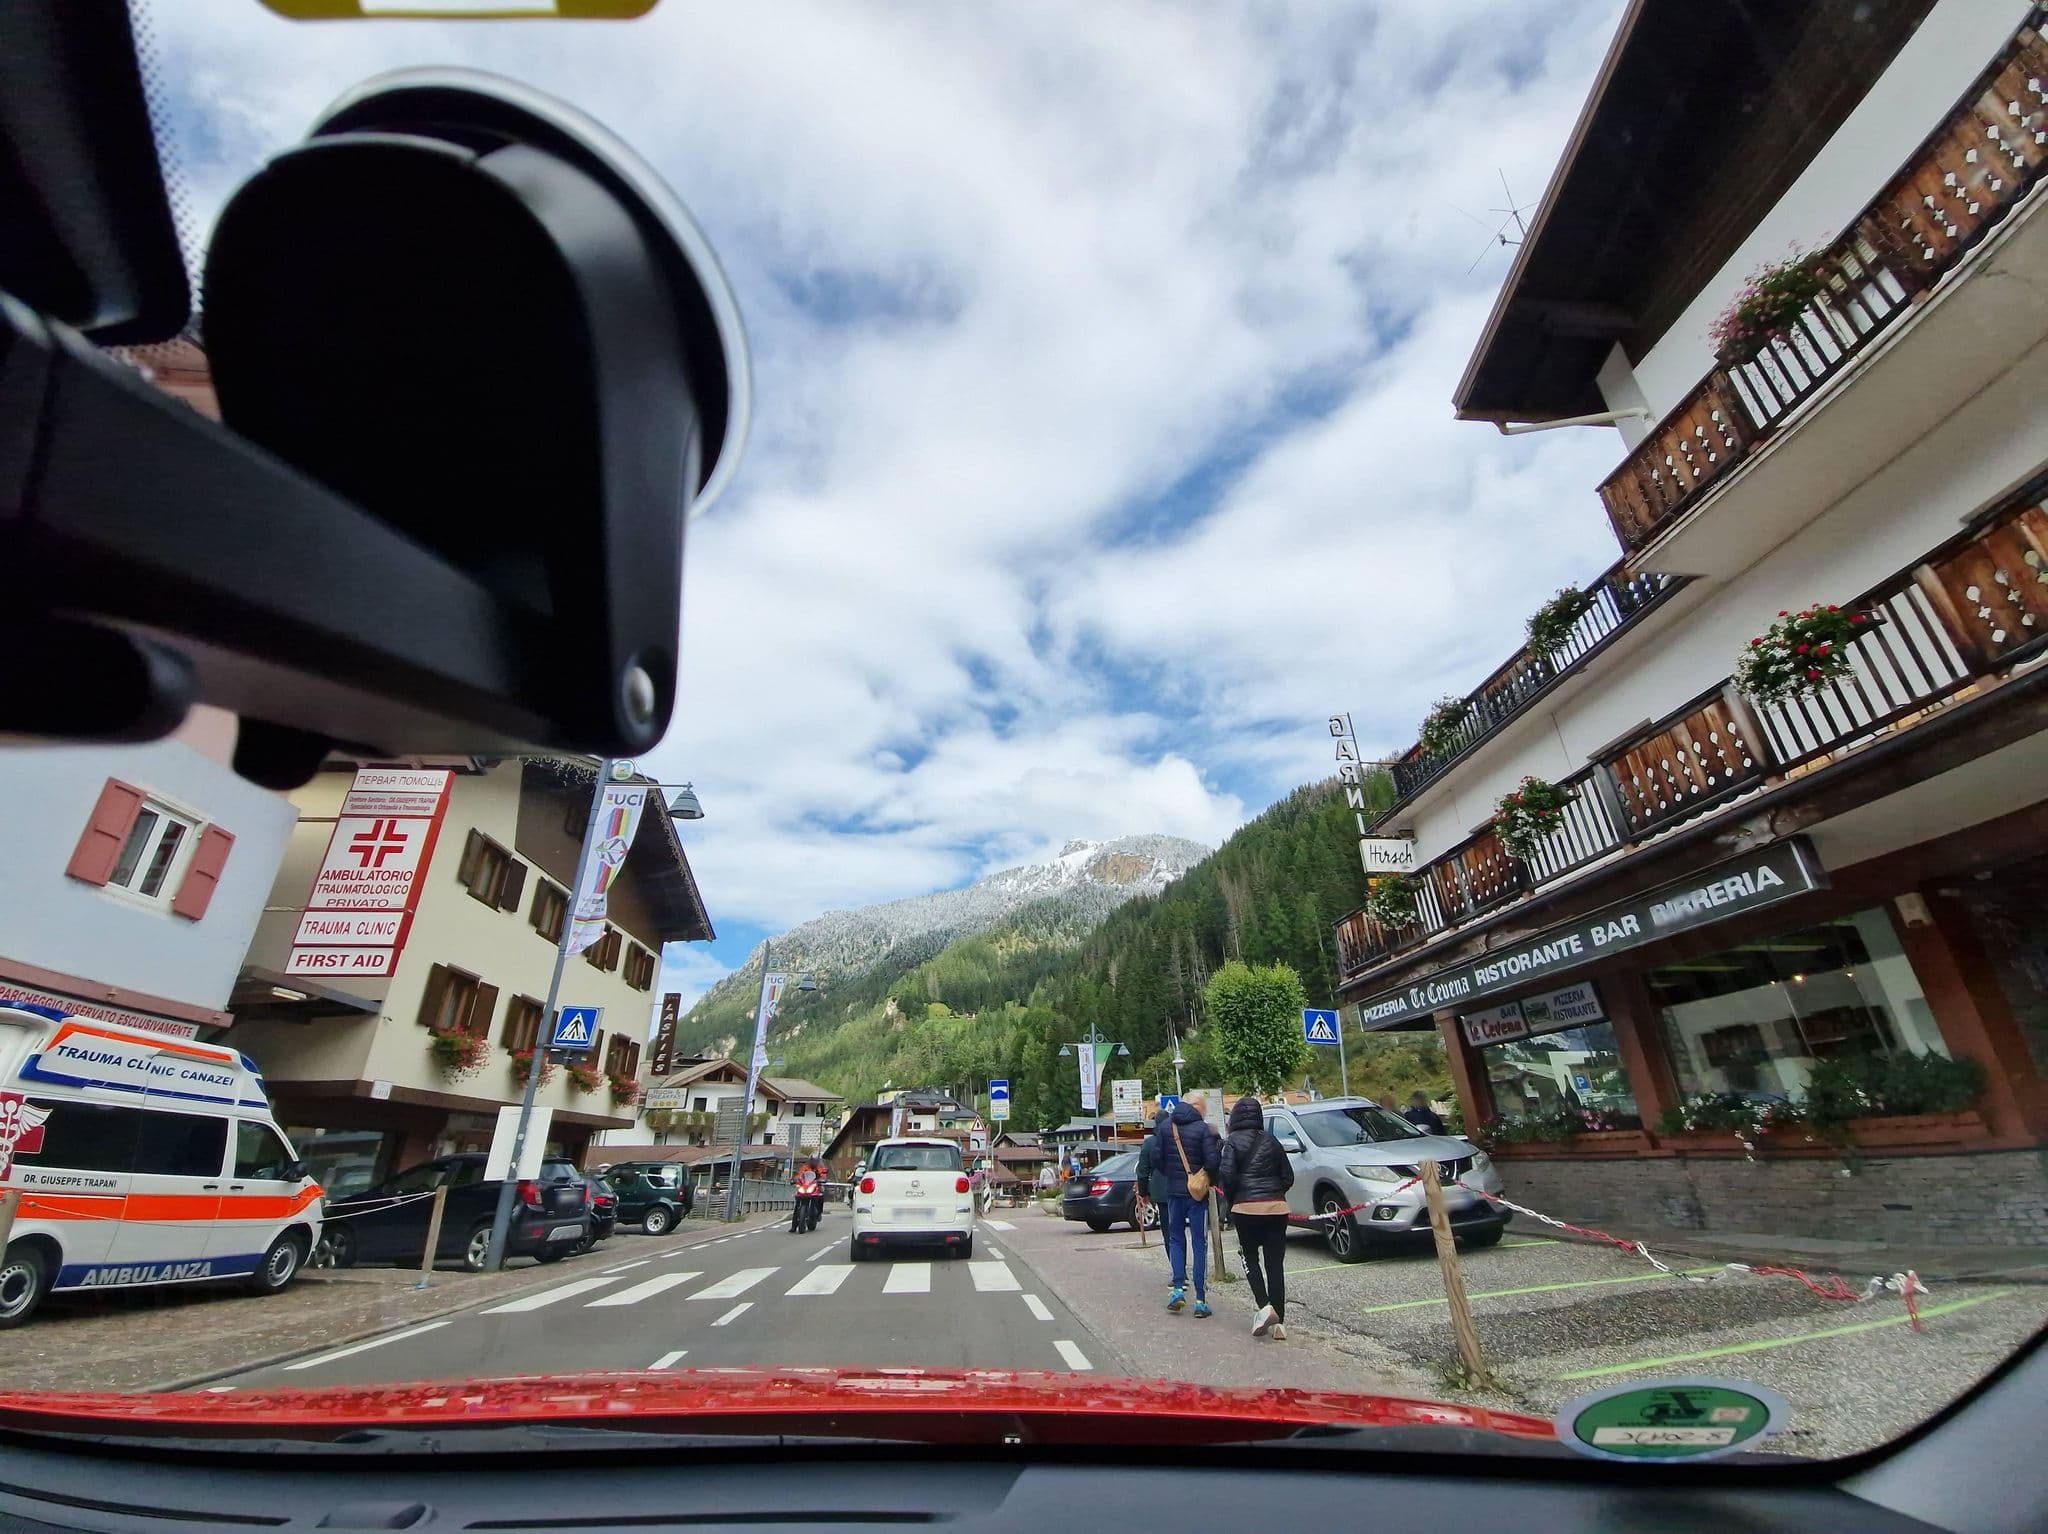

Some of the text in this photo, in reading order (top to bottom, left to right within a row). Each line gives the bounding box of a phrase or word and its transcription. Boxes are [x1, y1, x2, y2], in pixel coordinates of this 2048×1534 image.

[356, 775, 444, 787] ПЕРВАЯ ПОМОЩЬ
[614, 793, 644, 806] UCI
[1369, 843, 1413, 864] Hirsch
[321, 870, 413, 881] AMBULATORIO
[317, 884, 409, 894] TRAUMATOLOGICO
[326, 899, 389, 907] PRIVATO
[304, 921, 395, 935] TRAUMA CLINIC
[296, 954, 384, 967] FIRST AID
[1364, 997, 1407, 1023] PIZZERIA
[1474, 934, 1583, 987] RISTORANTE
[1590, 914, 1641, 946] BAR
[1553, 989, 1587, 1007] PIZZERIA
[1501, 1005, 1517, 1019] BAR
[1553, 1001, 1597, 1020] RISTORANTE
[63, 1002, 117, 1023] RISERVATO
[117, 1014, 193, 1038] ESCLUSIVAMENTE
[655, 1003, 674, 1072] LASTIES
[57, 1045, 234, 1087] TRAUMA CLINIC CANAZEI
[1576, 1076, 1585, 1088] P
[23, 1174, 117, 1188] DR. GIUSEPPE TRAPANI
[80, 1262, 212, 1286] AMBULANZA
